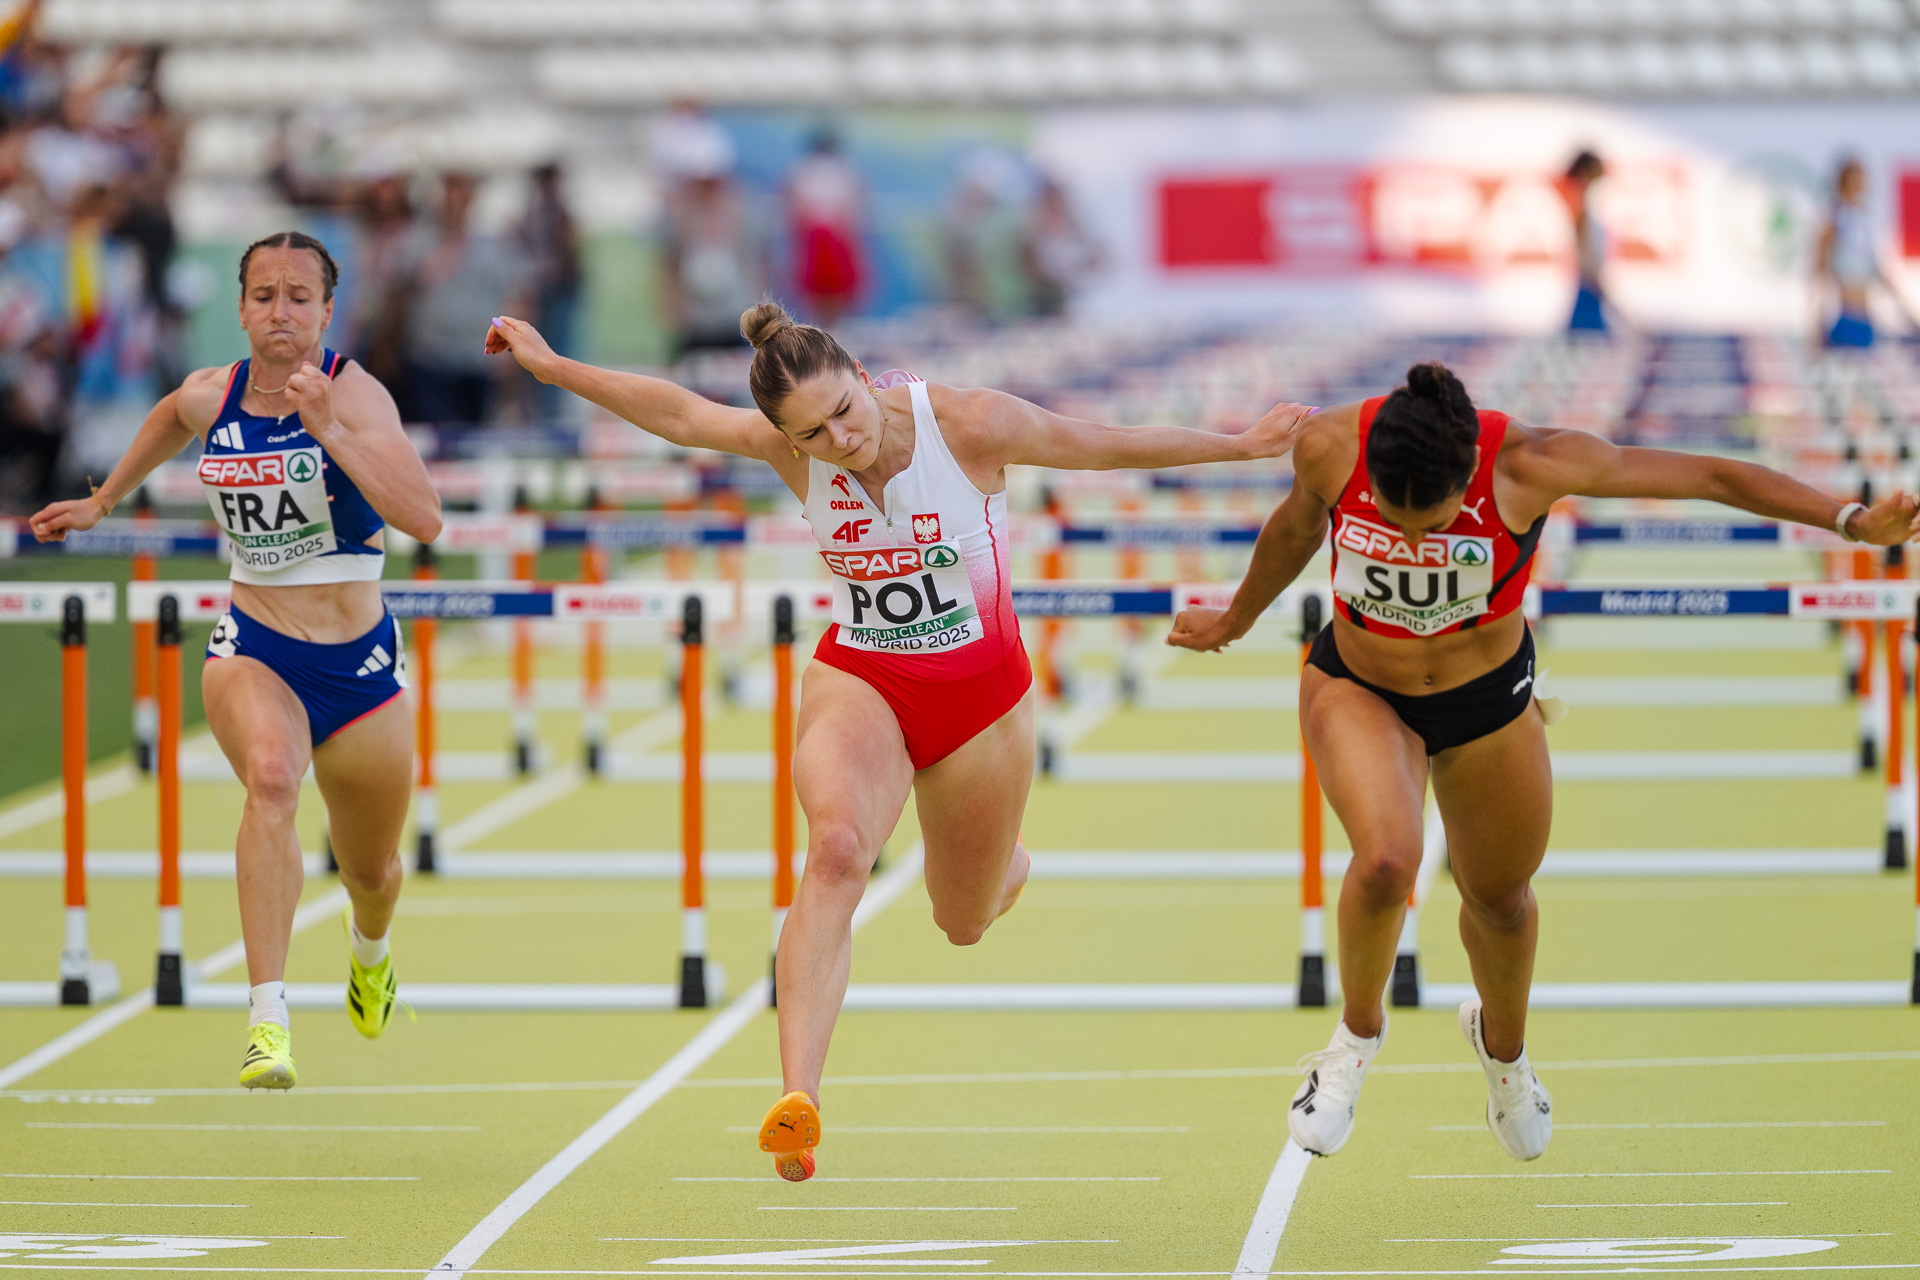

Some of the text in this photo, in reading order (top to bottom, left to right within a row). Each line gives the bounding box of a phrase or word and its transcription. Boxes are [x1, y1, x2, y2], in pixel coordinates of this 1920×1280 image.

[201, 458, 283, 483] SPAR
[219, 490, 309, 533] FRA
[830, 500, 864, 511] ORLEN
[832, 518, 873, 543] 4F
[284, 537, 323, 561] 2025
[1341, 524, 1445, 564] SPAR
[826, 550, 920, 577] SPAR
[847, 573, 958, 625] POL
[1364, 565, 1458, 608] SUI
[1350, 596, 1475, 632] MADRID 2025
[851, 624, 971, 650] MADRID 2025
[869, 629, 898, 641] RUN
